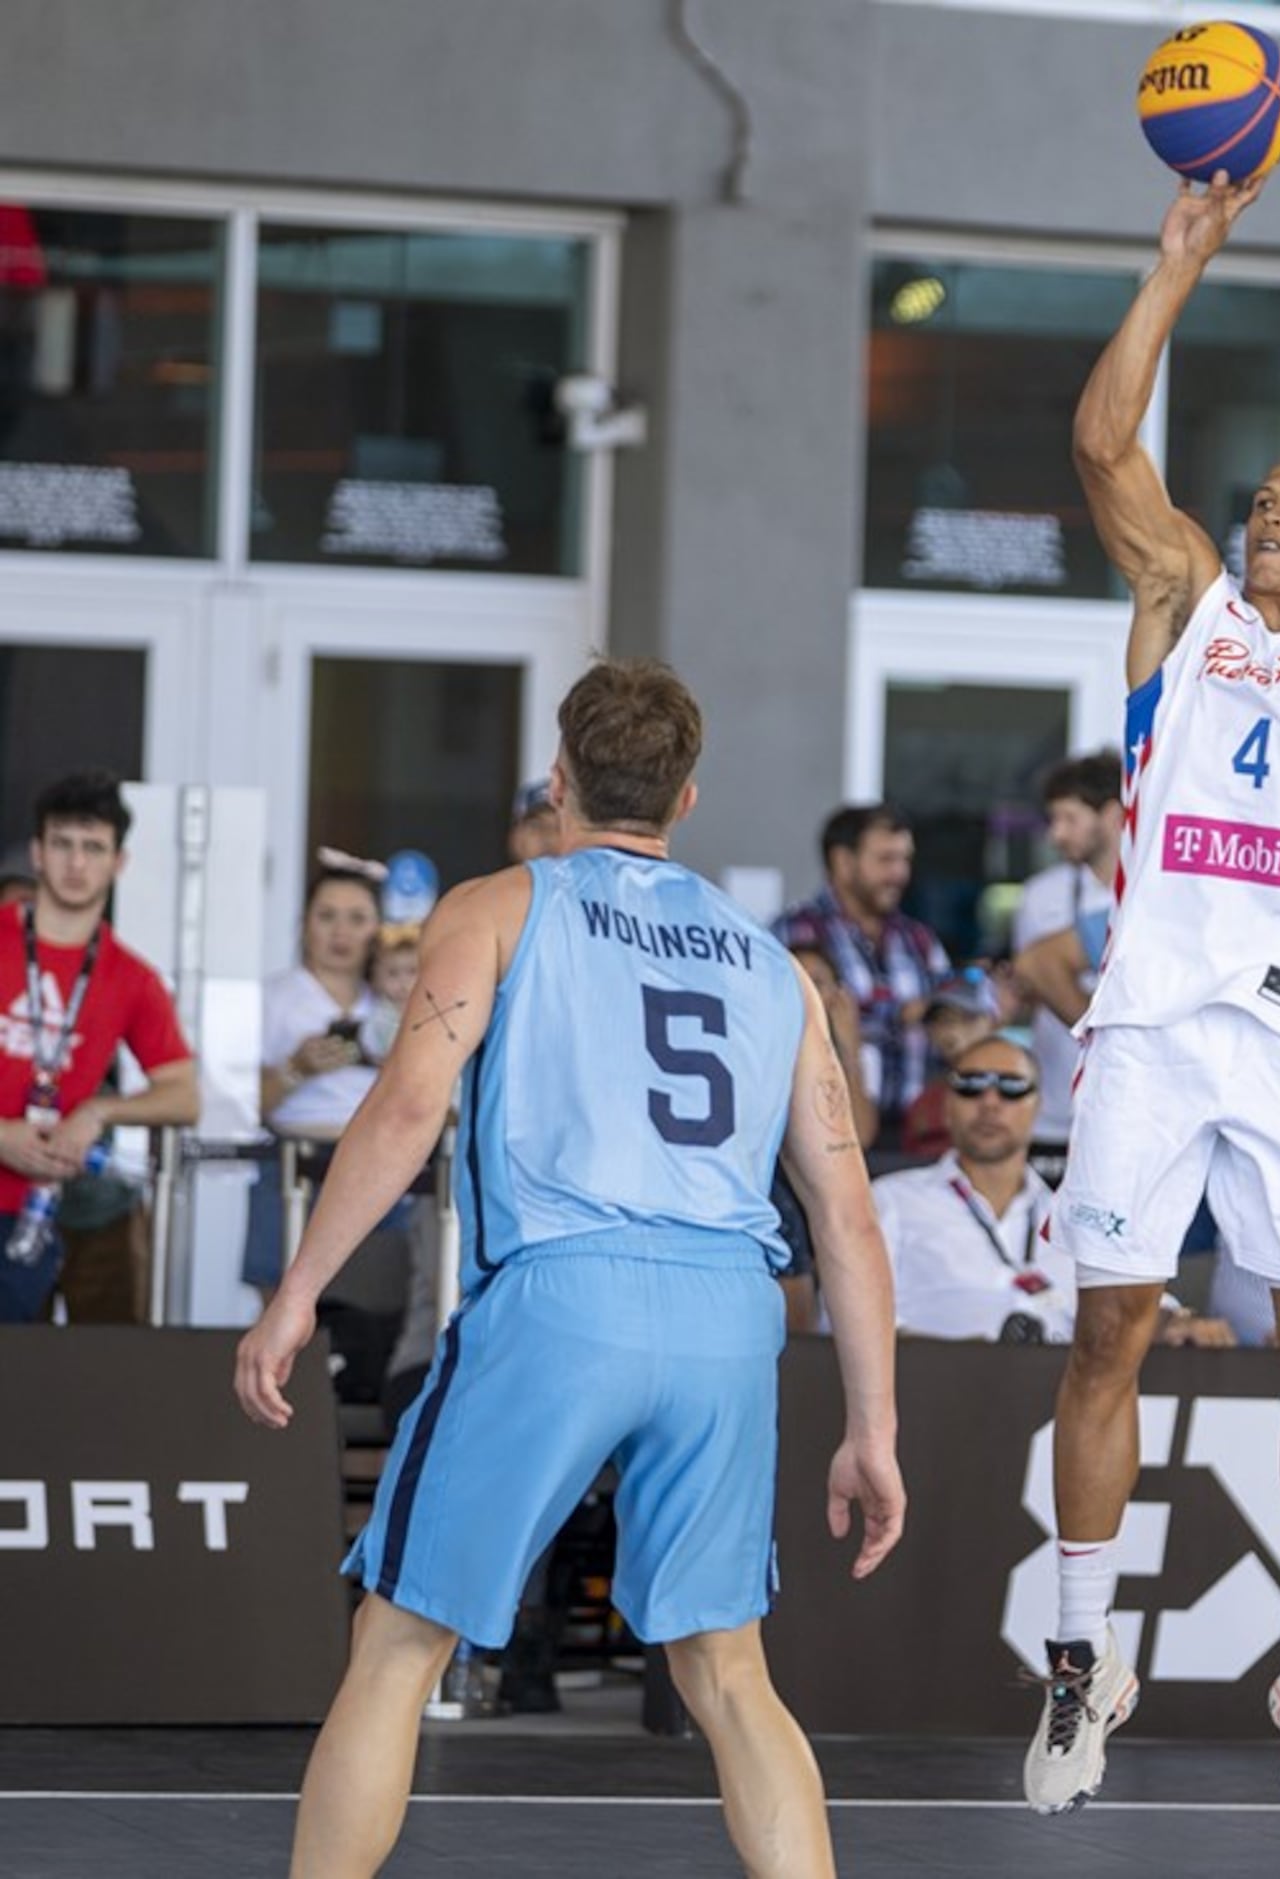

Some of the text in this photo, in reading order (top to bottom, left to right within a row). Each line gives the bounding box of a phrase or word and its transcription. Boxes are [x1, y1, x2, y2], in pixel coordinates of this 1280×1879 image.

[1232, 717, 1271, 789] 4
[580, 899, 753, 970] WOLINSKY
[640, 982, 736, 1148] 5
